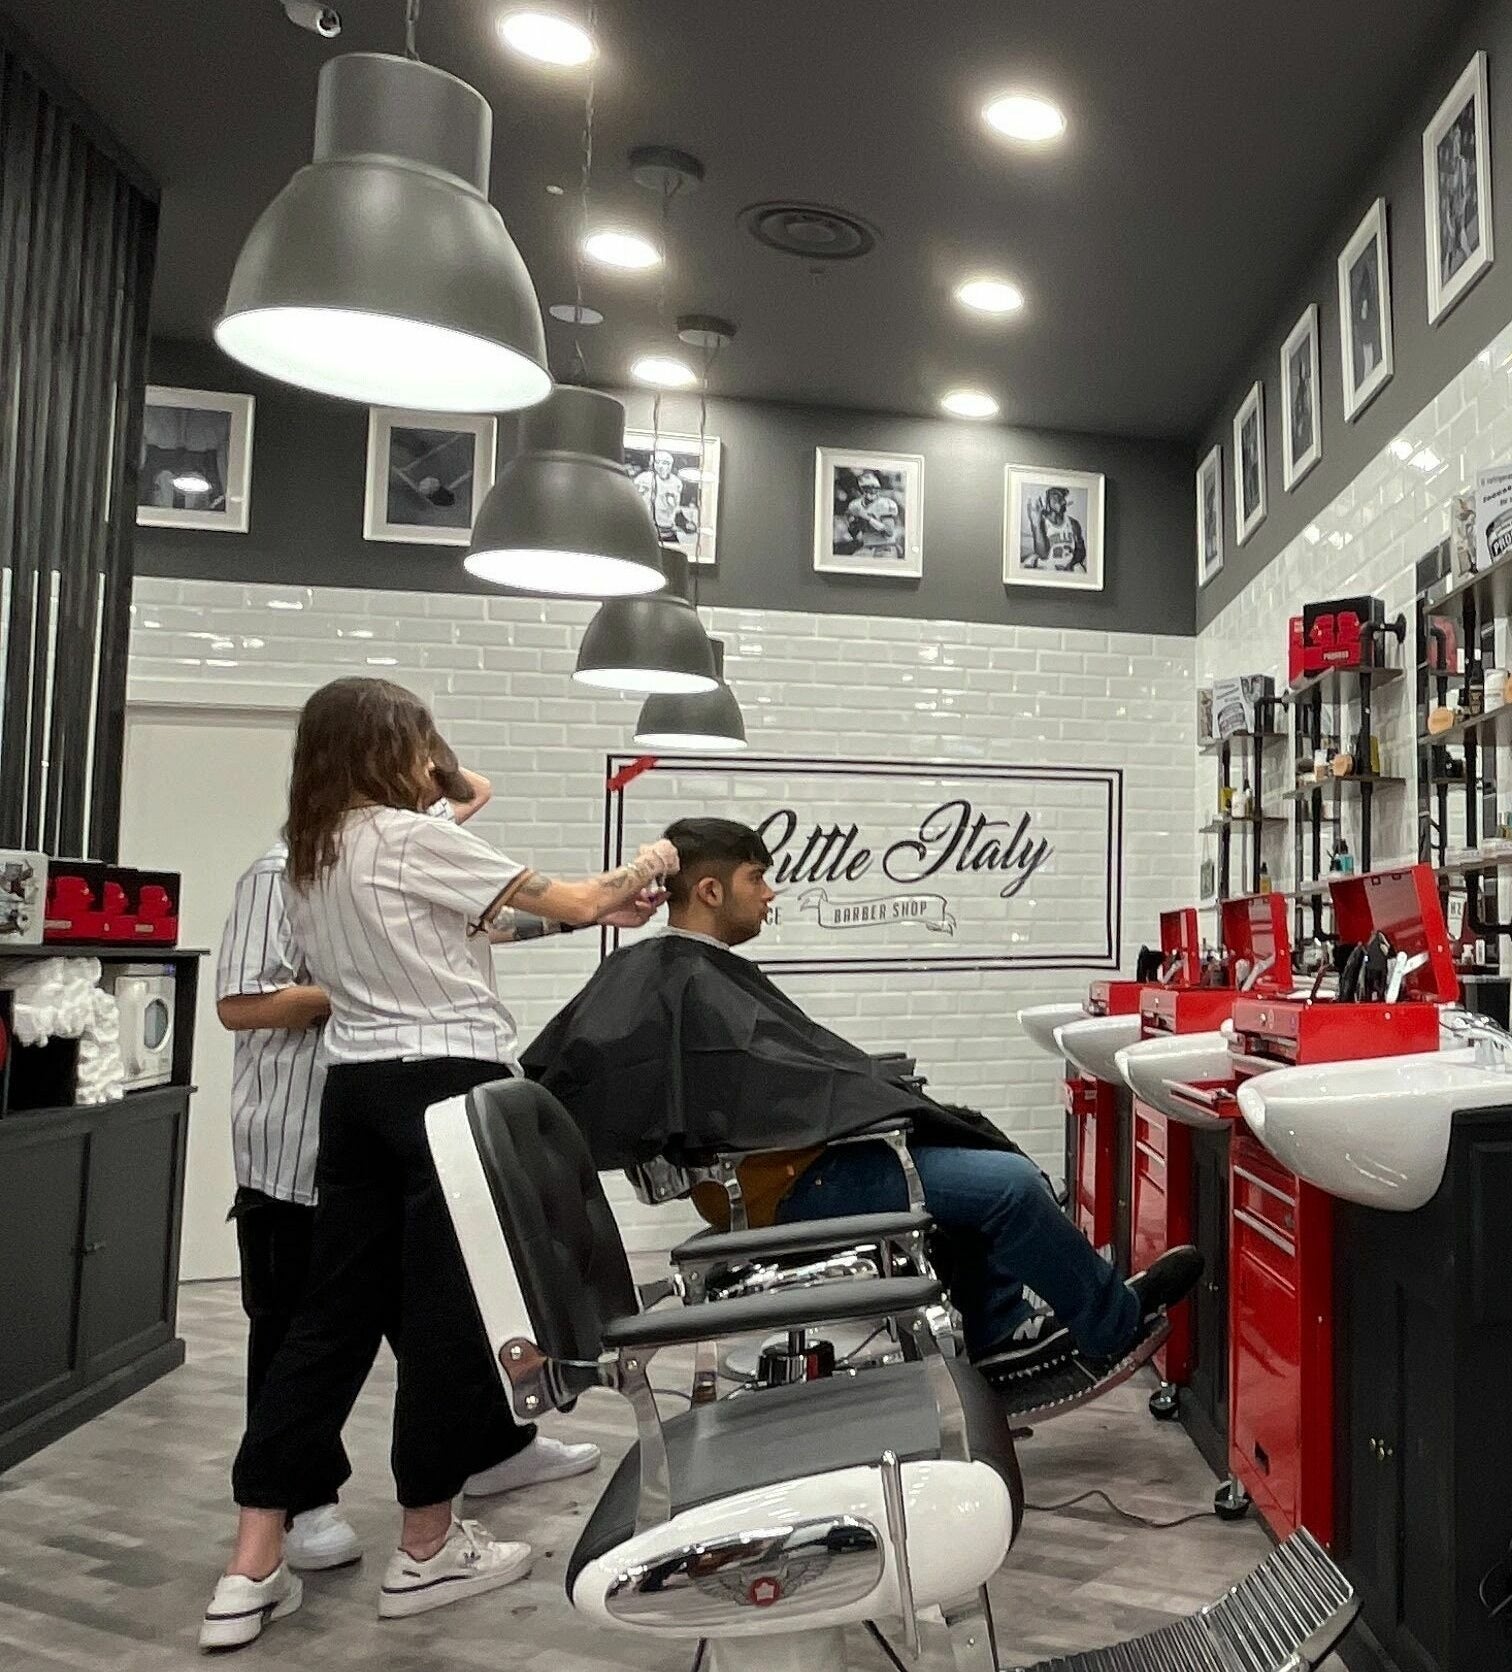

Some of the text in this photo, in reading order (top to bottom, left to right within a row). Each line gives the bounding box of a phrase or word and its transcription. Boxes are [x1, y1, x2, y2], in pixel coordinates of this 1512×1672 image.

[882, 799, 1054, 899] Italy
[833, 901, 927, 924] BARBER SHOP
